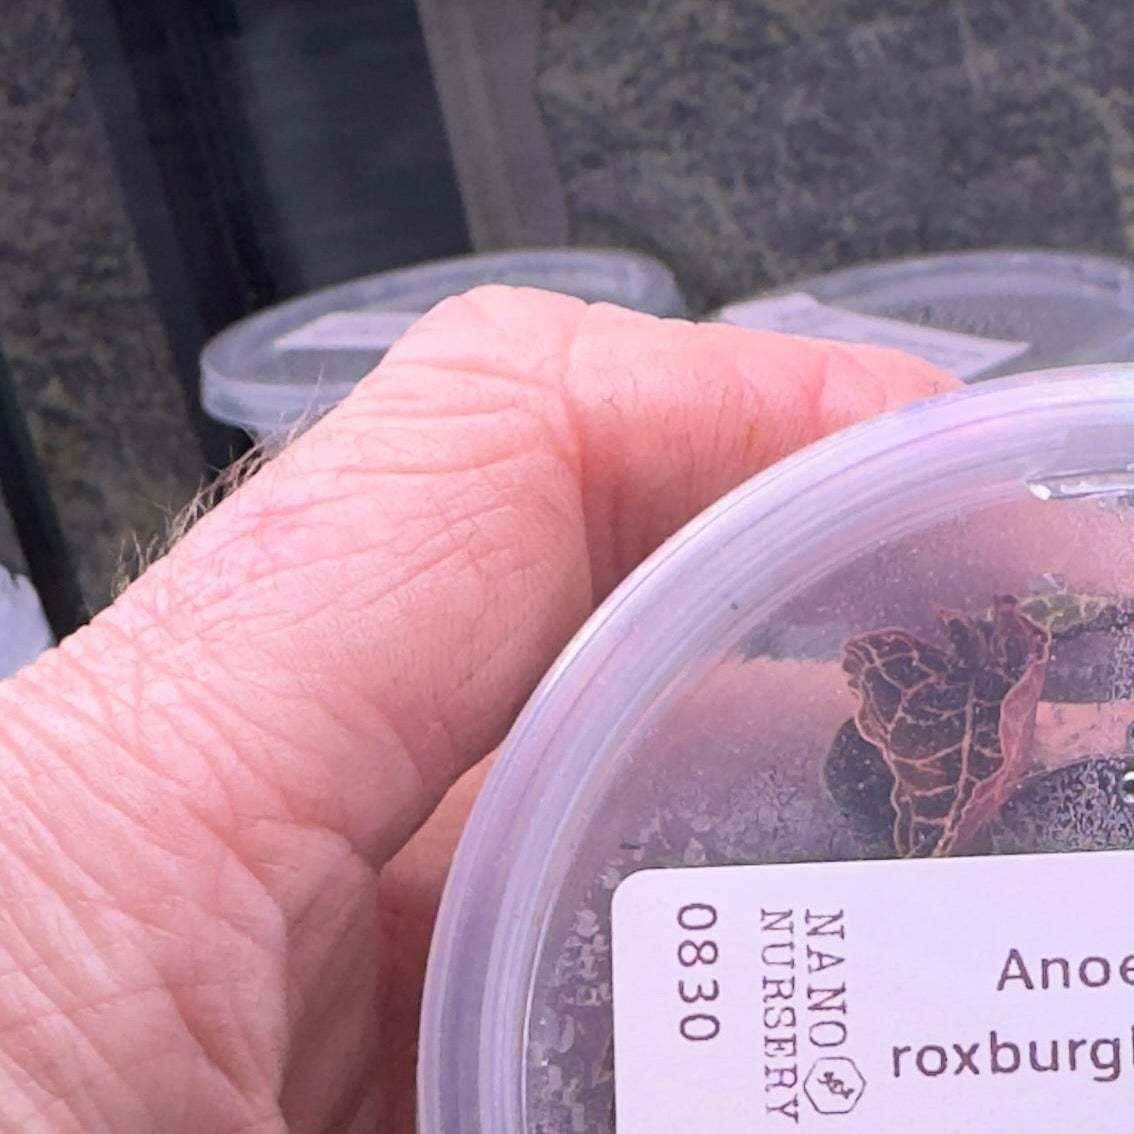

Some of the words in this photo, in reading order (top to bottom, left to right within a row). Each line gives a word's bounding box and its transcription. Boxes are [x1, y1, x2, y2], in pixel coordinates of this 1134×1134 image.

[676, 903, 721, 1042] 0830
[759, 908, 799, 1124] NURSERY
[804, 908, 848, 1048] NANO
